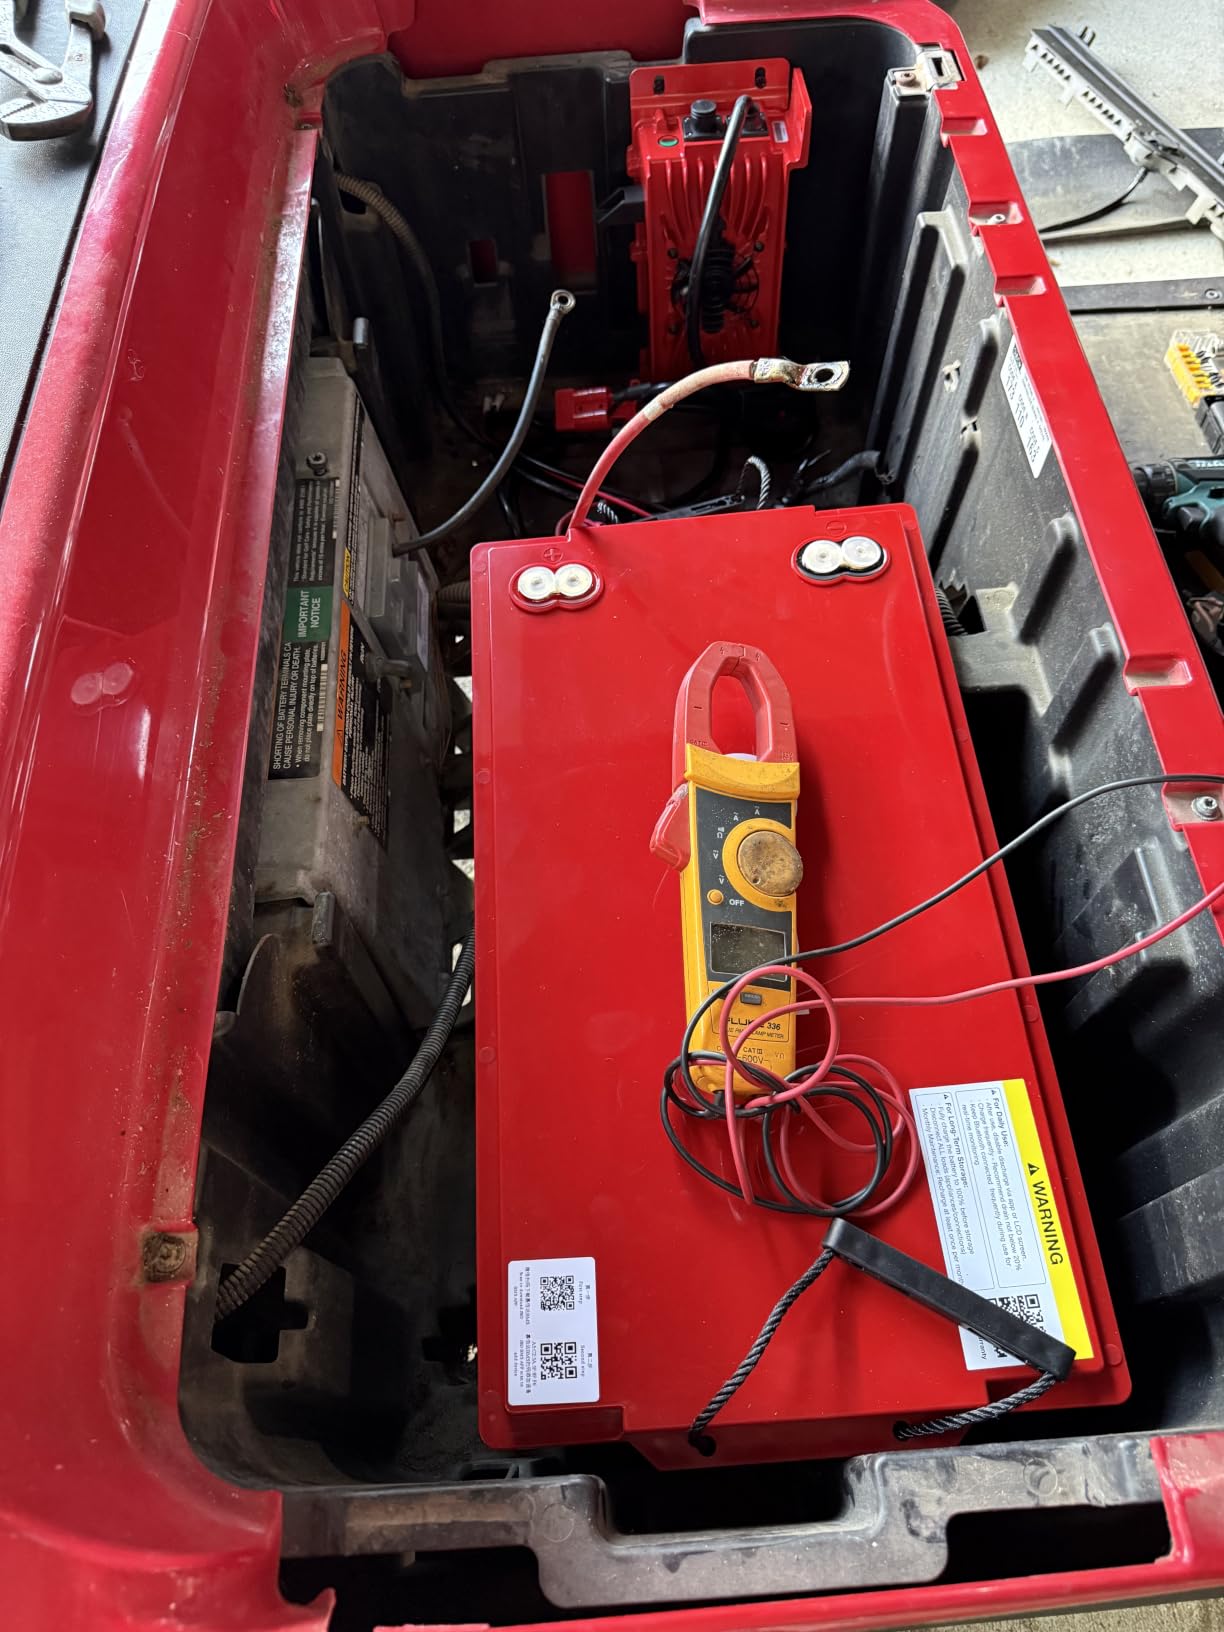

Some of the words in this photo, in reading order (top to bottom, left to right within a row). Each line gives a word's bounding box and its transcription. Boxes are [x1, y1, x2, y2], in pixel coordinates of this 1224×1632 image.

[297, 590, 309, 637] IMPORTANT
[310, 597, 320, 627] NOTICE
[283, 642, 291, 651] CA
[280, 652, 291, 689] TERMINALS
[290, 670, 299, 680] OR
[301, 662, 310, 687] mounting
[309, 674, 317, 683] top
[288, 681, 298, 705] INJURY
[337, 651, 347, 720] WARNING
[277, 690, 287, 720] BATTERY
[299, 688, 308, 718] component
[307, 692, 316, 712] directly
[276, 721, 284, 731] OF
[285, 706, 296, 743] PERSONAL
[306, 712, 314, 726] plate
[296, 719, 305, 744] removing
[304, 727, 313, 743] place
[272, 732, 283, 769] SHORTING
[282, 744, 292, 768] CAUSE
[295, 745, 303, 762] When
[303, 743, 311, 753] not
[303, 753, 311, 762] do
[767, 1022, 781, 1031] 336
[936, 1106, 946, 1120] Fully
[944, 1102, 953, 1114] For
[969, 1103, 978, 1119] Keep
[977, 1102, 987, 1124] Charge
[985, 1102, 994, 1116] After
[991, 1097, 1001, 1109] For
[921, 1108, 932, 1132] Monthly
[929, 1107, 942, 1141] Disconnect
[994, 1111, 1006, 1128] Daily
[940, 1121, 950, 1142] charge
[947, 1116, 962, 1154] Long-Term
[961, 1104, 972, 1130] real-time
[967, 1132, 980, 1165] monitoring
[973, 1120, 985, 1150] Bluetooth
[982, 1126, 995, 1156] frequently
[999, 1130, 1010, 1147] Use:
[936, 1142, 945, 1155] ALL
[945, 1144, 953, 1154] the
[992, 1132, 1003, 1154] disable
[926, 1133, 941, 1175] Maintenance:
[939, 1156, 949, 1173] loads
[947, 1155, 958, 1177] battery
[956, 1156, 969, 1187] Storage:
[980, 1151, 993, 1184] connected
[997, 1155, 1010, 1186] discharge
[935, 1177, 948, 1206] Recharge
[990, 1162, 1005, 1202] Recommend
[1004, 1187, 1013, 1196] via
[954, 1188, 964, 1205] 100%
[988, 1188, 1001, 1219] frequently
[1007, 1198, 1016, 1210] app
[943, 1175, 966, 1254] (appliances/connections)
[958, 1207, 969, 1228] before
[1000, 1203, 1010, 1219] drain
[944, 1216, 953, 1232] least
[995, 1221, 1006, 1242] during
[1004, 1221, 1012, 1231] not
[1012, 1220, 1022, 1235] LCD
[1031, 1181, 1063, 1264] WARNING
[947, 1233, 957, 1250] once
[963, 1229, 975, 1254] storage
[1000, 1243, 1009, 1255] use
[1007, 1233, 1017, 1253] below
[951, 1251, 959, 1262] per
[1004, 1257, 1012, 1266] for
[1012, 1255, 1021, 1270] 20%
